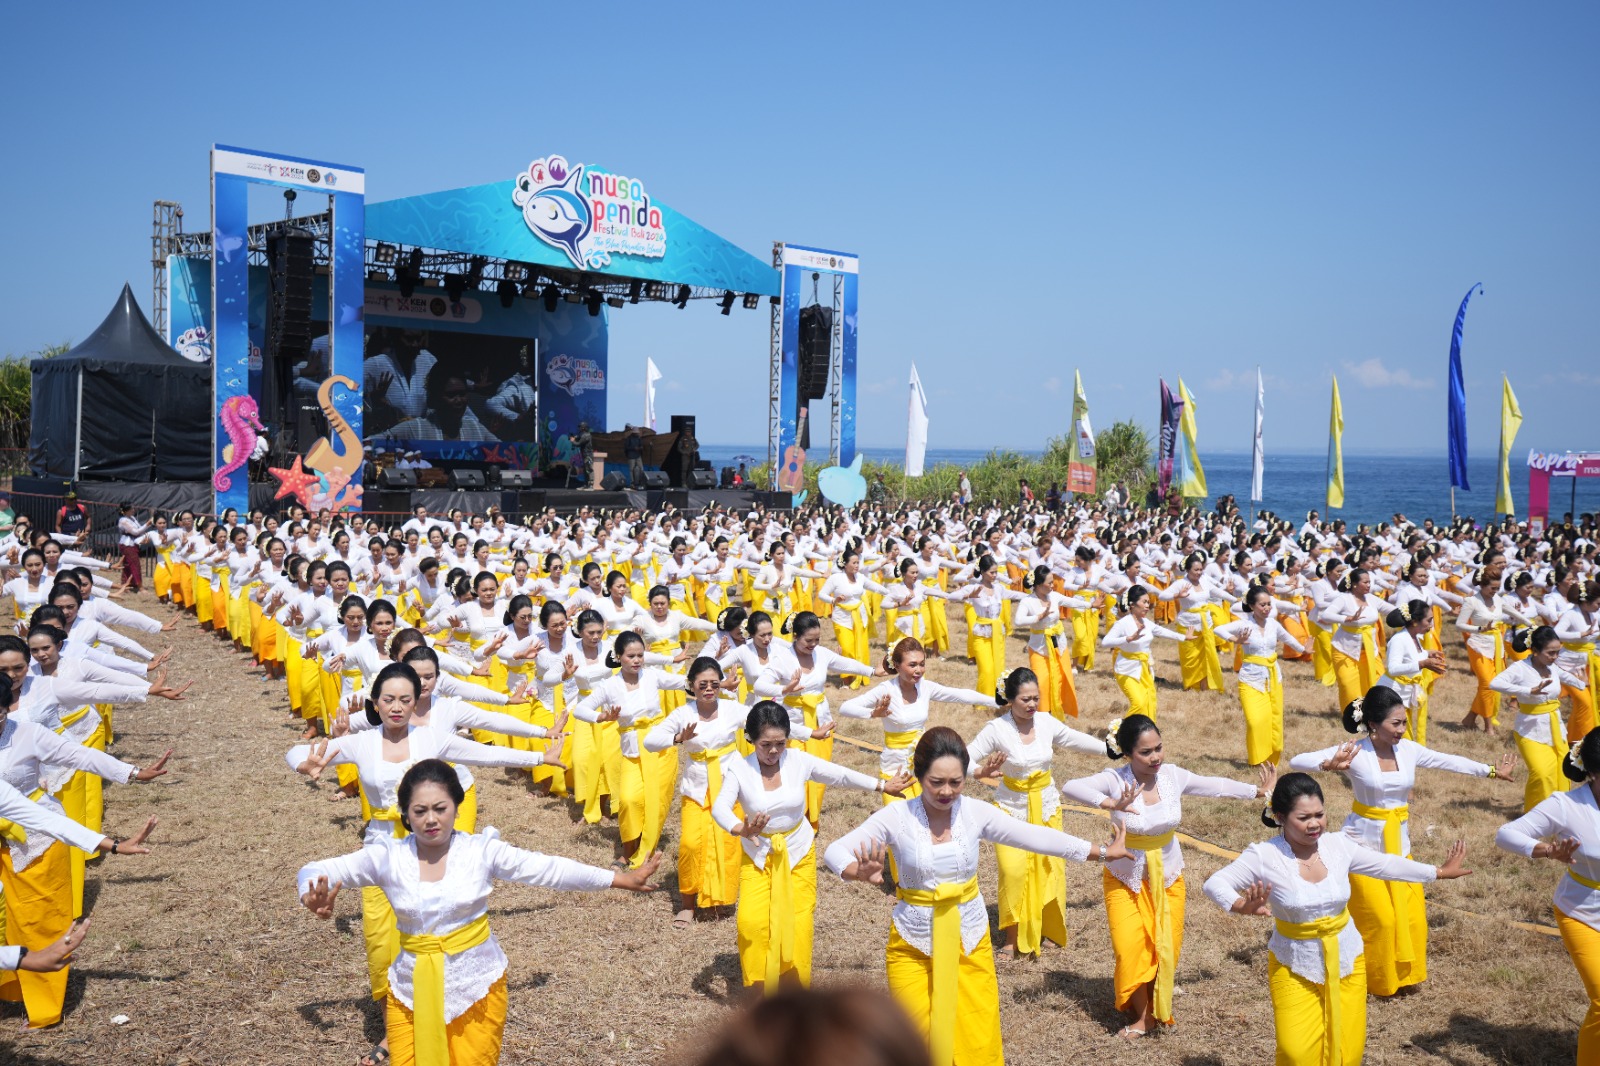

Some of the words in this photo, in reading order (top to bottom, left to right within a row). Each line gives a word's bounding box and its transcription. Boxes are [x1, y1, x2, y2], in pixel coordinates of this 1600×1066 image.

[590, 174, 643, 202] nusa
[591, 195, 662, 232] penida
[598, 223, 629, 237] Festival
[631, 227, 645, 239] Bali
[593, 237, 604, 247] The
[410, 298, 427, 307] KEN
[410, 305, 427, 313] 2024
[1527, 448, 1577, 472] kopra
